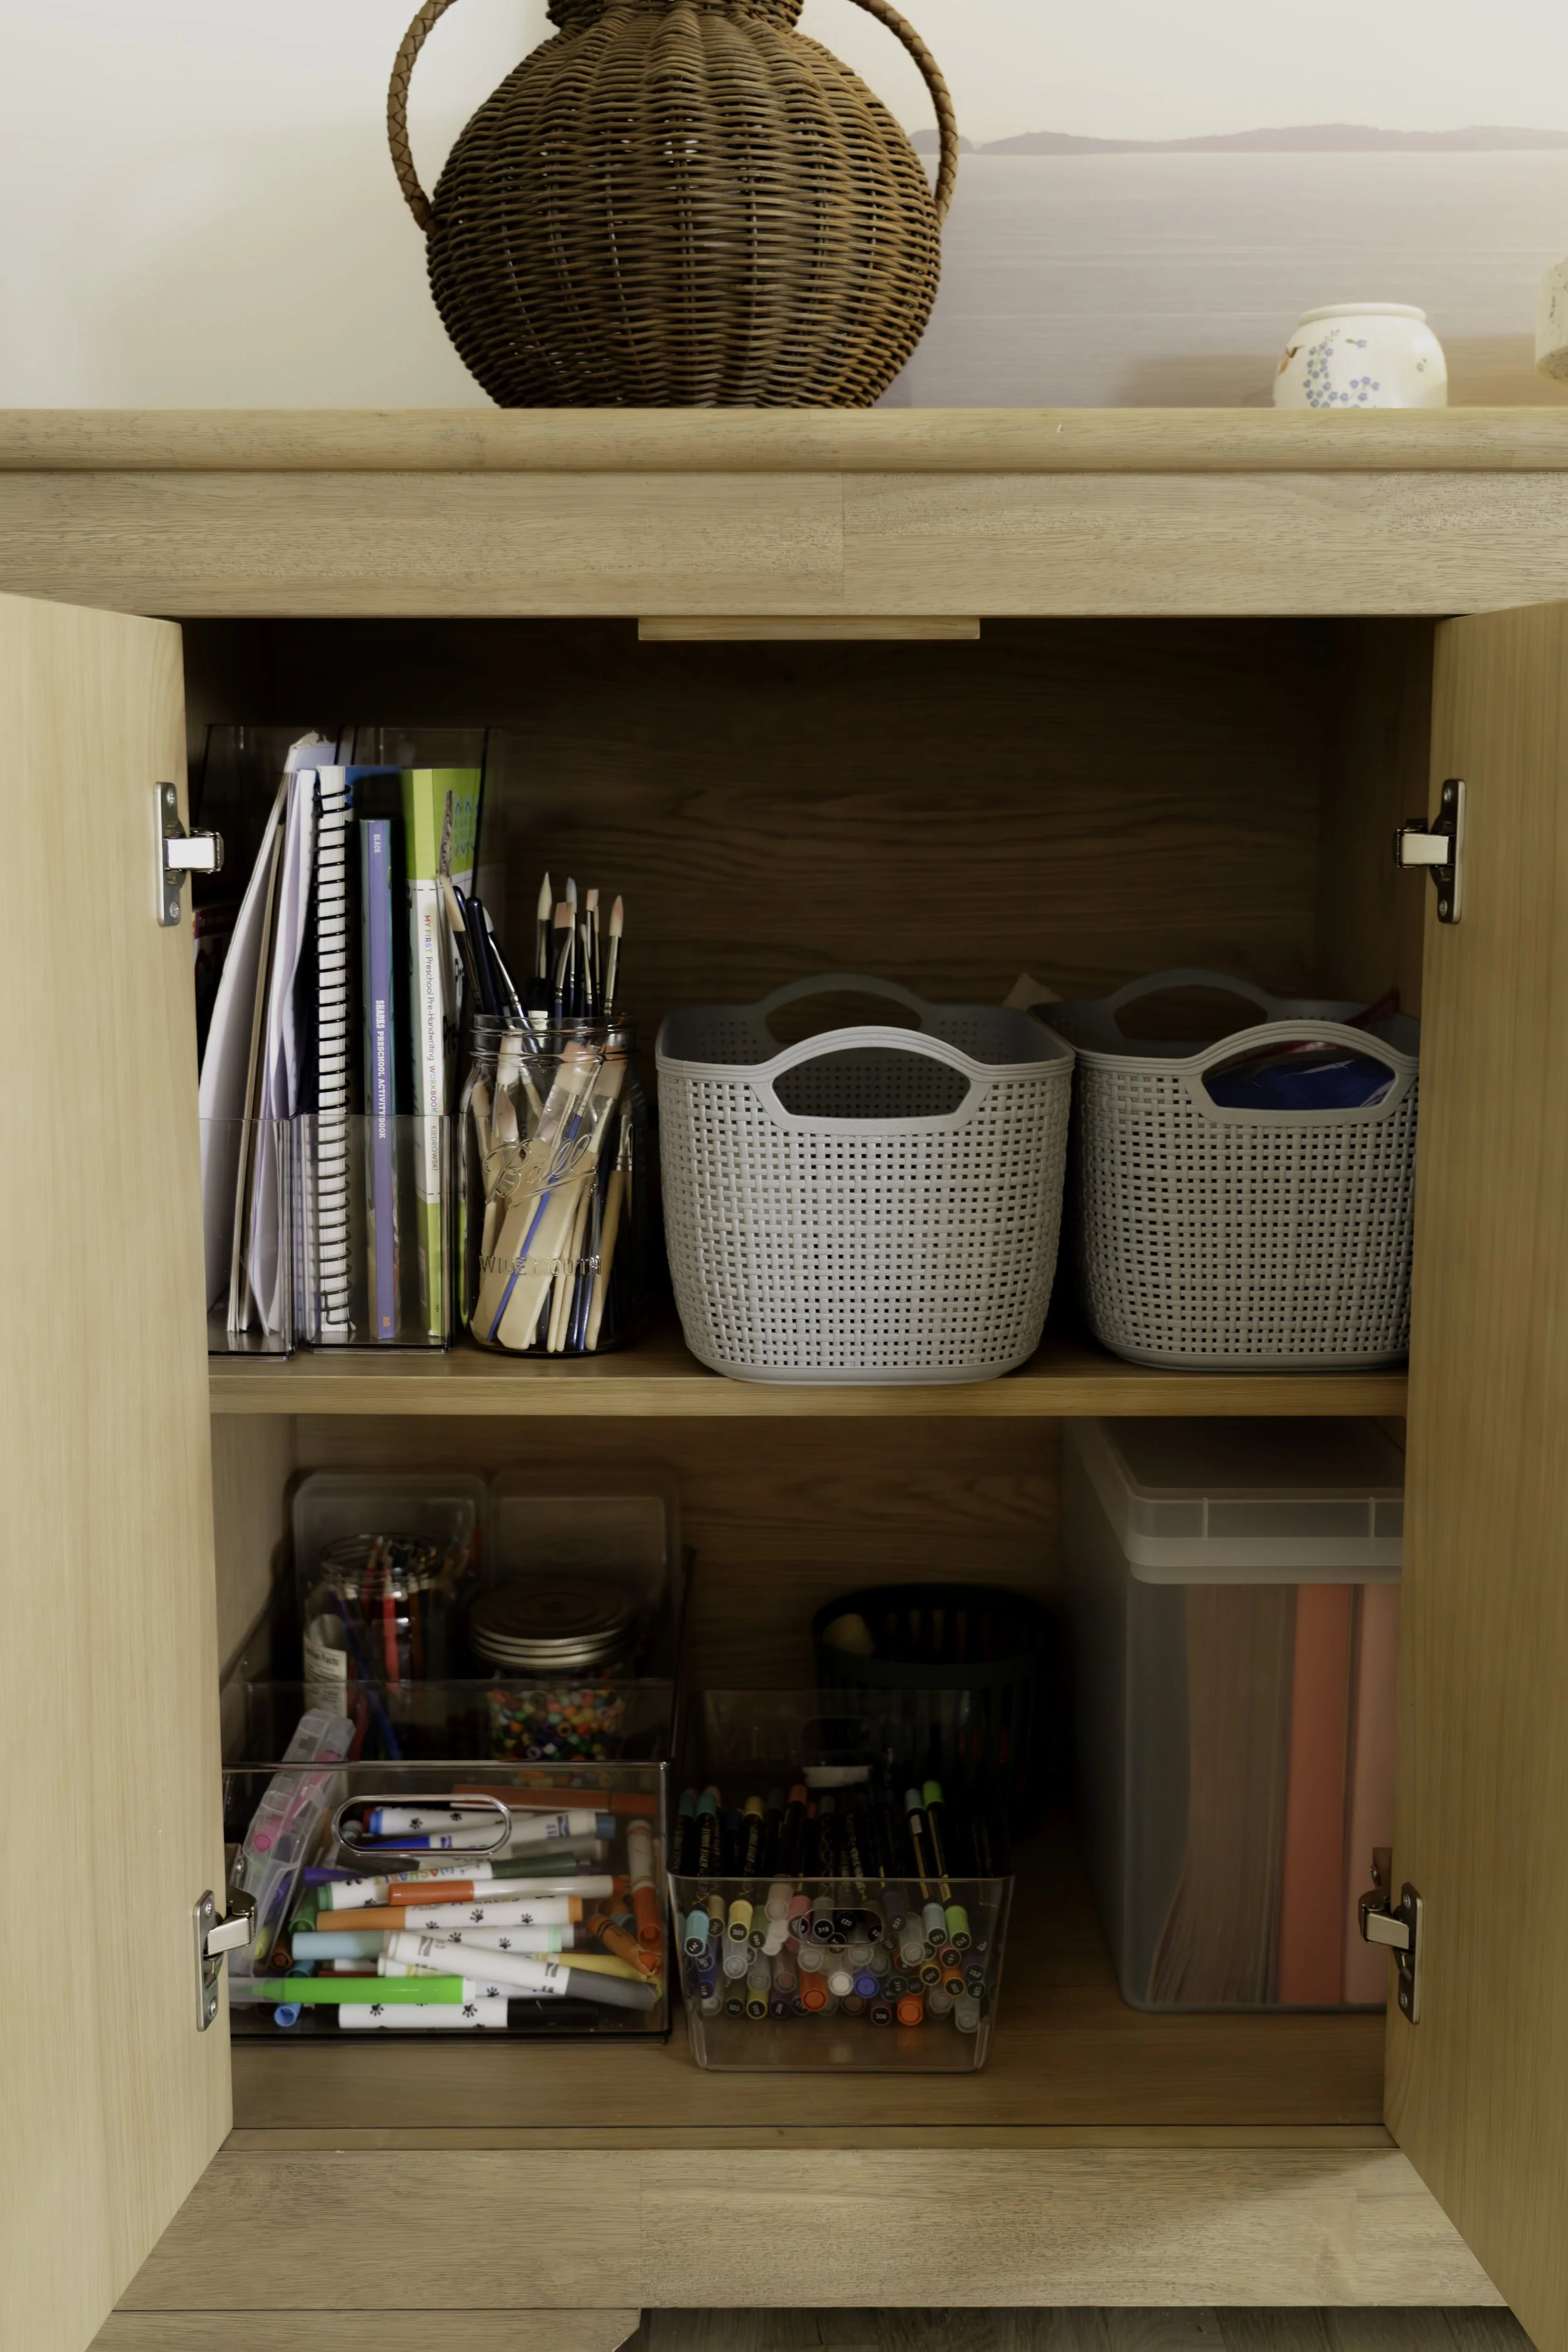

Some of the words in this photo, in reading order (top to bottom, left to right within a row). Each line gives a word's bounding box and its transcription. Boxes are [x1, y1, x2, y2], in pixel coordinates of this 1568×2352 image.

[424, 915, 432, 927] MY
[375, 1000, 386, 1029] SHARKS
[427, 997, 436, 1061] Pre-Handwriting
[377, 1030, 385, 1077] PRESCHOOL
[378, 1078, 386, 1115] ACTIVITY
[429, 1066, 438, 1113] WORKBOOK
[378, 1116, 386, 1138] BOOK
[484, 1133, 592, 1205] Ball
[479, 1255, 527, 1275] WIDE
[534, 1255, 602, 1276] MOUTH
